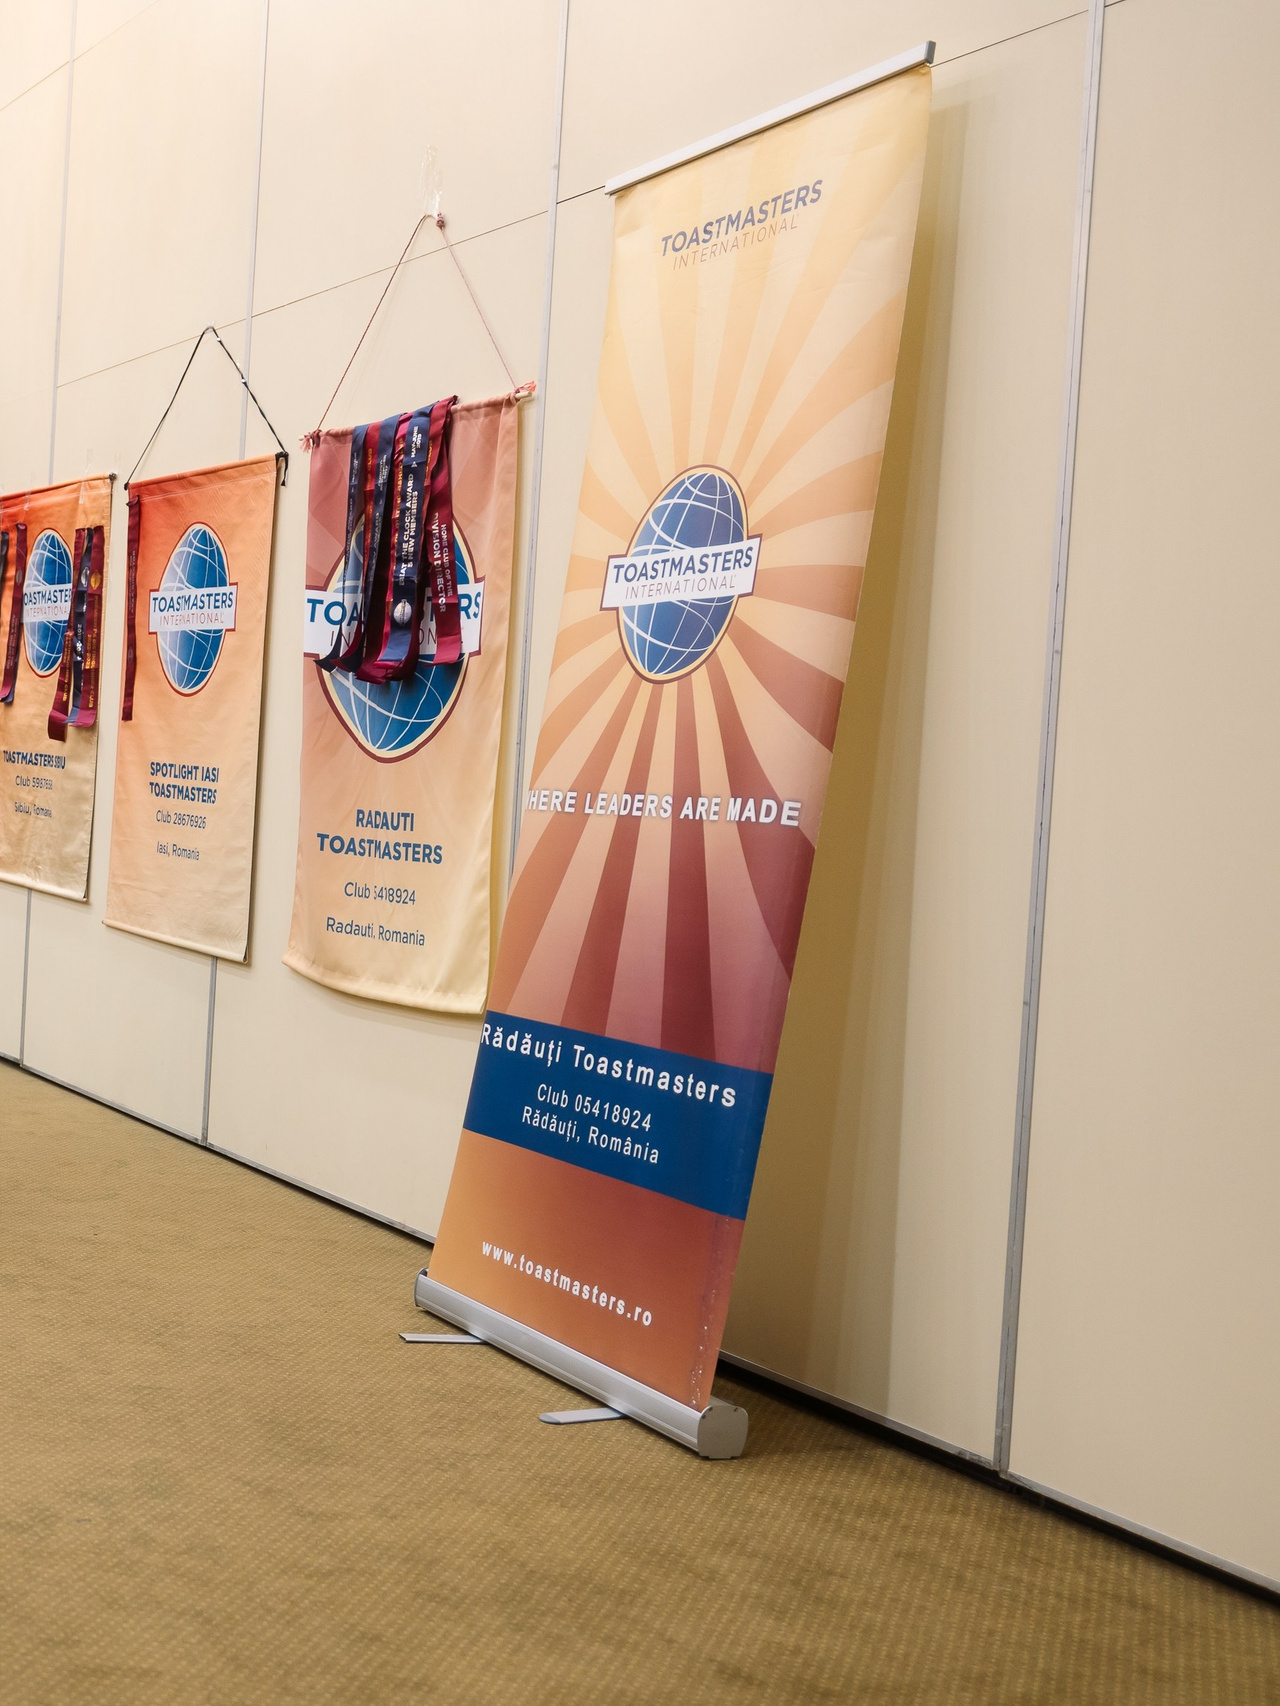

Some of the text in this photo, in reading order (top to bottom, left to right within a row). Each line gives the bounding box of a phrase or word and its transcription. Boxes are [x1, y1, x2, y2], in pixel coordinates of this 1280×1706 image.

[661, 179, 823, 257] TOASTMASTERS
[673, 214, 799, 271] INTERNATIONAL
[406, 474, 414, 508] AWARD
[404, 509, 412, 541] CLOCK
[410, 491, 418, 536] MEMBERS
[407, 538, 415, 560] NEW
[431, 512, 447, 613] DIVISION DIRECTOR
[445, 568, 452, 580] OF
[613, 546, 753, 584] TOASTMASTERS
[625, 574, 736, 600] INTERNATIONAL
[152, 591, 234, 613] TOASTMASTERS
[160, 612, 224, 626] INTERNATIONAL
[3, 750, 54, 768] TOASTMASTERS
[15, 775, 31, 787] Club
[150, 761, 220, 783] SPOTLIGHT IASI
[149, 781, 217, 804] TOASTMASTERS
[14, 801, 32, 816] Sibiu,
[156, 809, 207, 829] Club 28676926
[355, 809, 415, 832] RADAUTI
[526, 790, 803, 827] HERE LEADERS ARE MADE
[156, 841, 200, 861] Iasi, Romania
[316, 832, 443, 865] TOASTMASTERS
[344, 882, 416, 905] Club 5418924
[378, 925, 426, 947] Romania
[573, 1044, 738, 1108] Toastmasters
[537, 1083, 652, 1132] Club 05418924
[588, 1126, 660, 1164] România
[481, 1240, 653, 1327] www.toastmasters.ro
